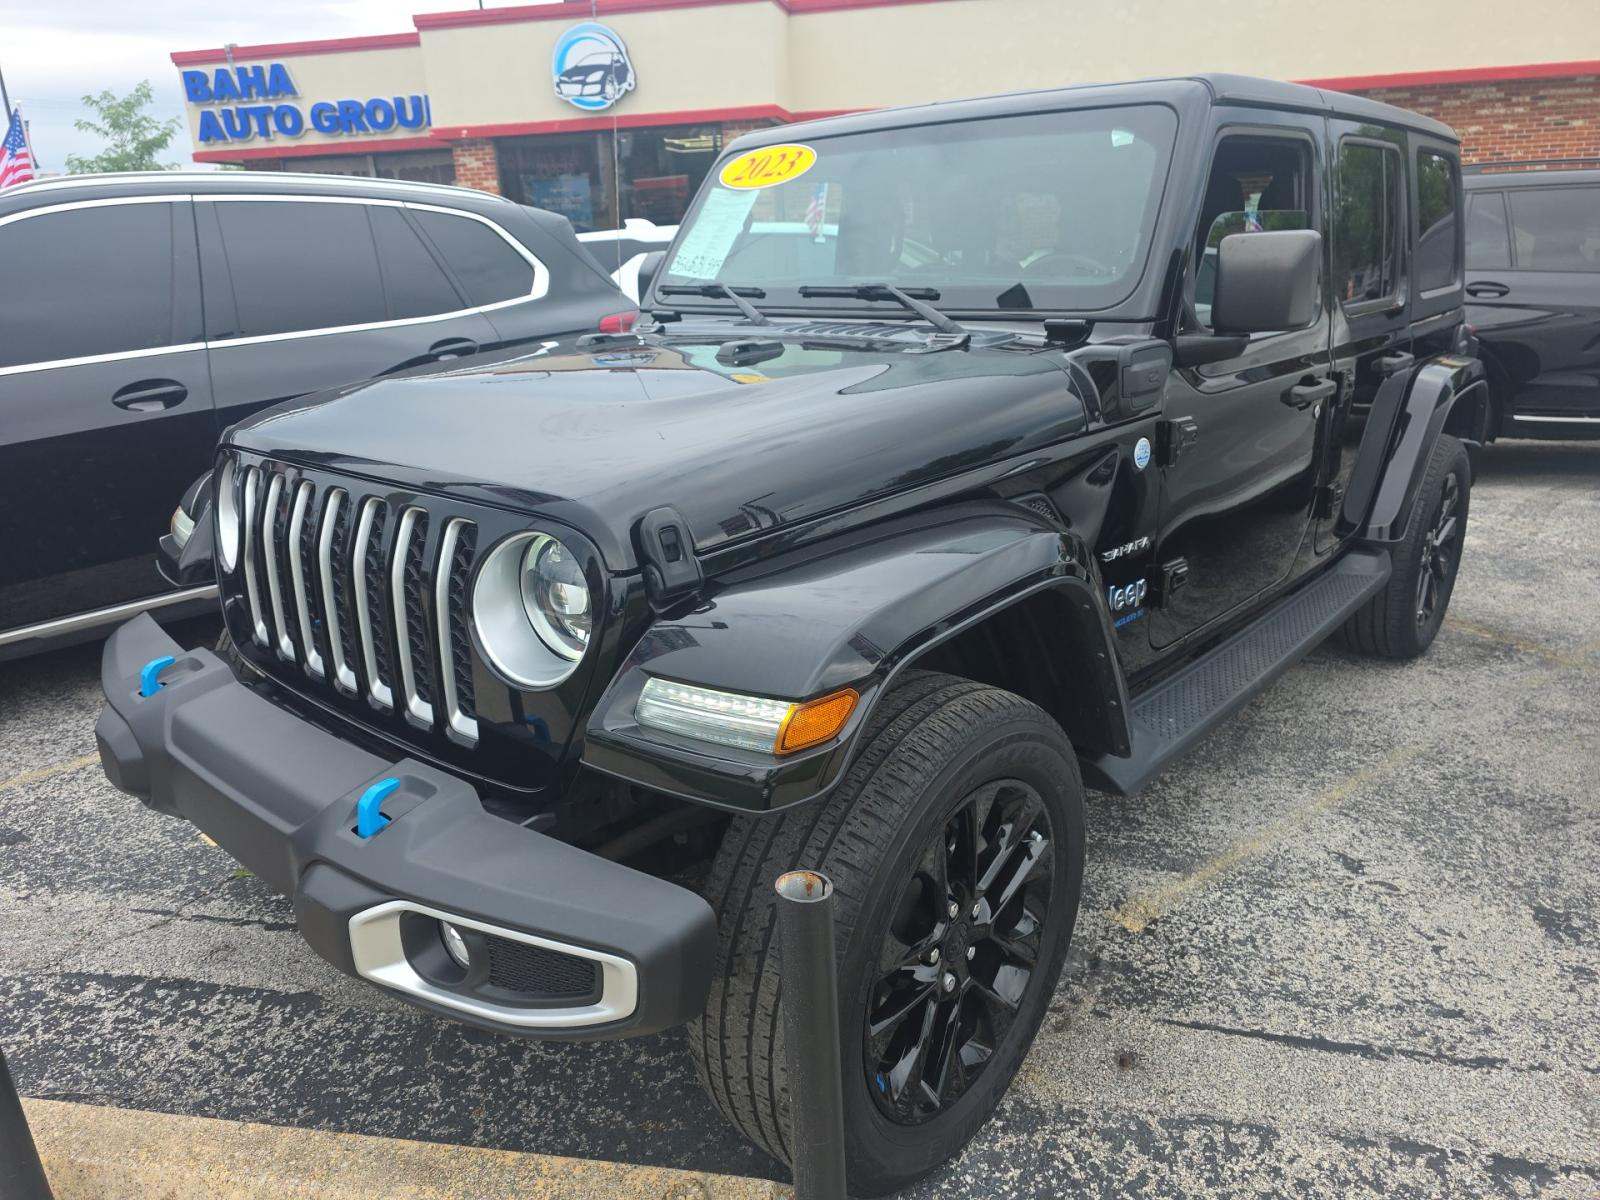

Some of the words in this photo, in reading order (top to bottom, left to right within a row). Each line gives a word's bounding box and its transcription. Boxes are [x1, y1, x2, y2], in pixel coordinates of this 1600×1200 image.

[182, 63, 298, 104] BAHA
[198, 104, 304, 144] AUTO
[310, 94, 432, 136] GROU
[732, 150, 804, 182] 2023
